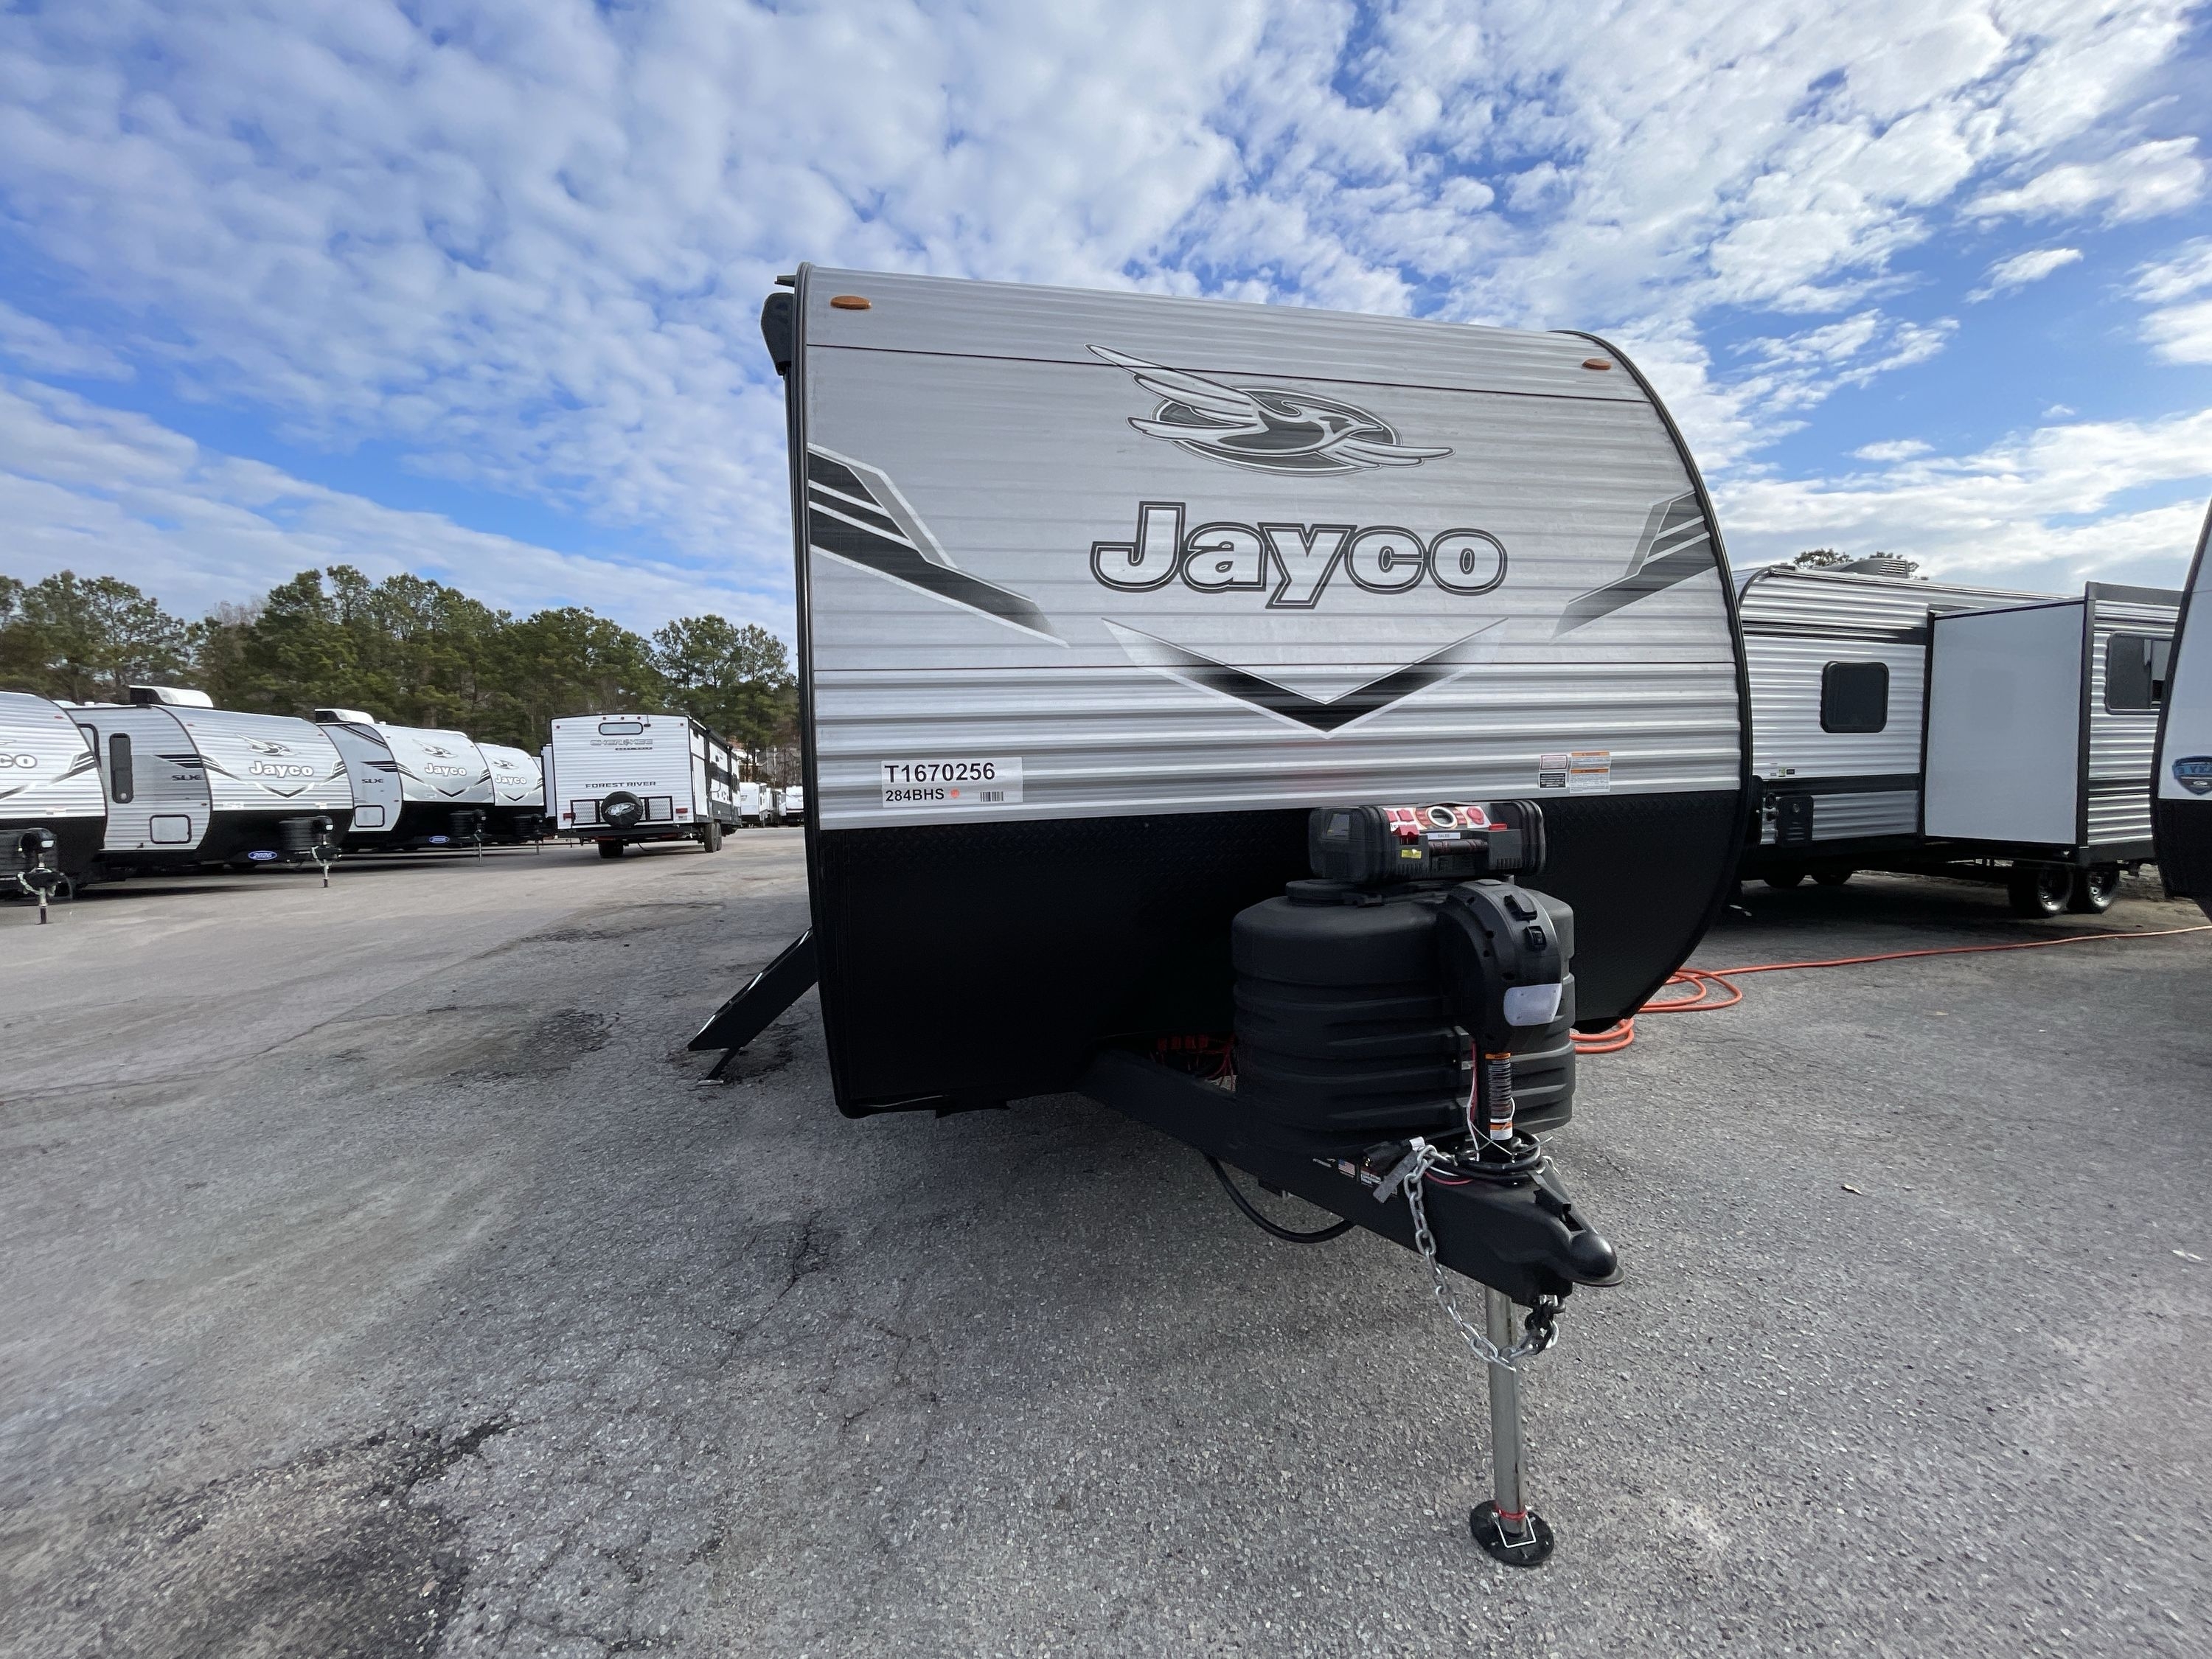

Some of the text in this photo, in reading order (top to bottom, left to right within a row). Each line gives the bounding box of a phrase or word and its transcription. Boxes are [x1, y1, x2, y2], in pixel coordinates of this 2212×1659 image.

[1090, 501, 1509, 610] Jayco
[248, 760, 314, 778] Jayco
[424, 762, 467, 776] Jayco
[884, 762, 995, 783] T1670256
[495, 773, 526, 785] Jayco
[885, 788, 945, 801] 284BHS
